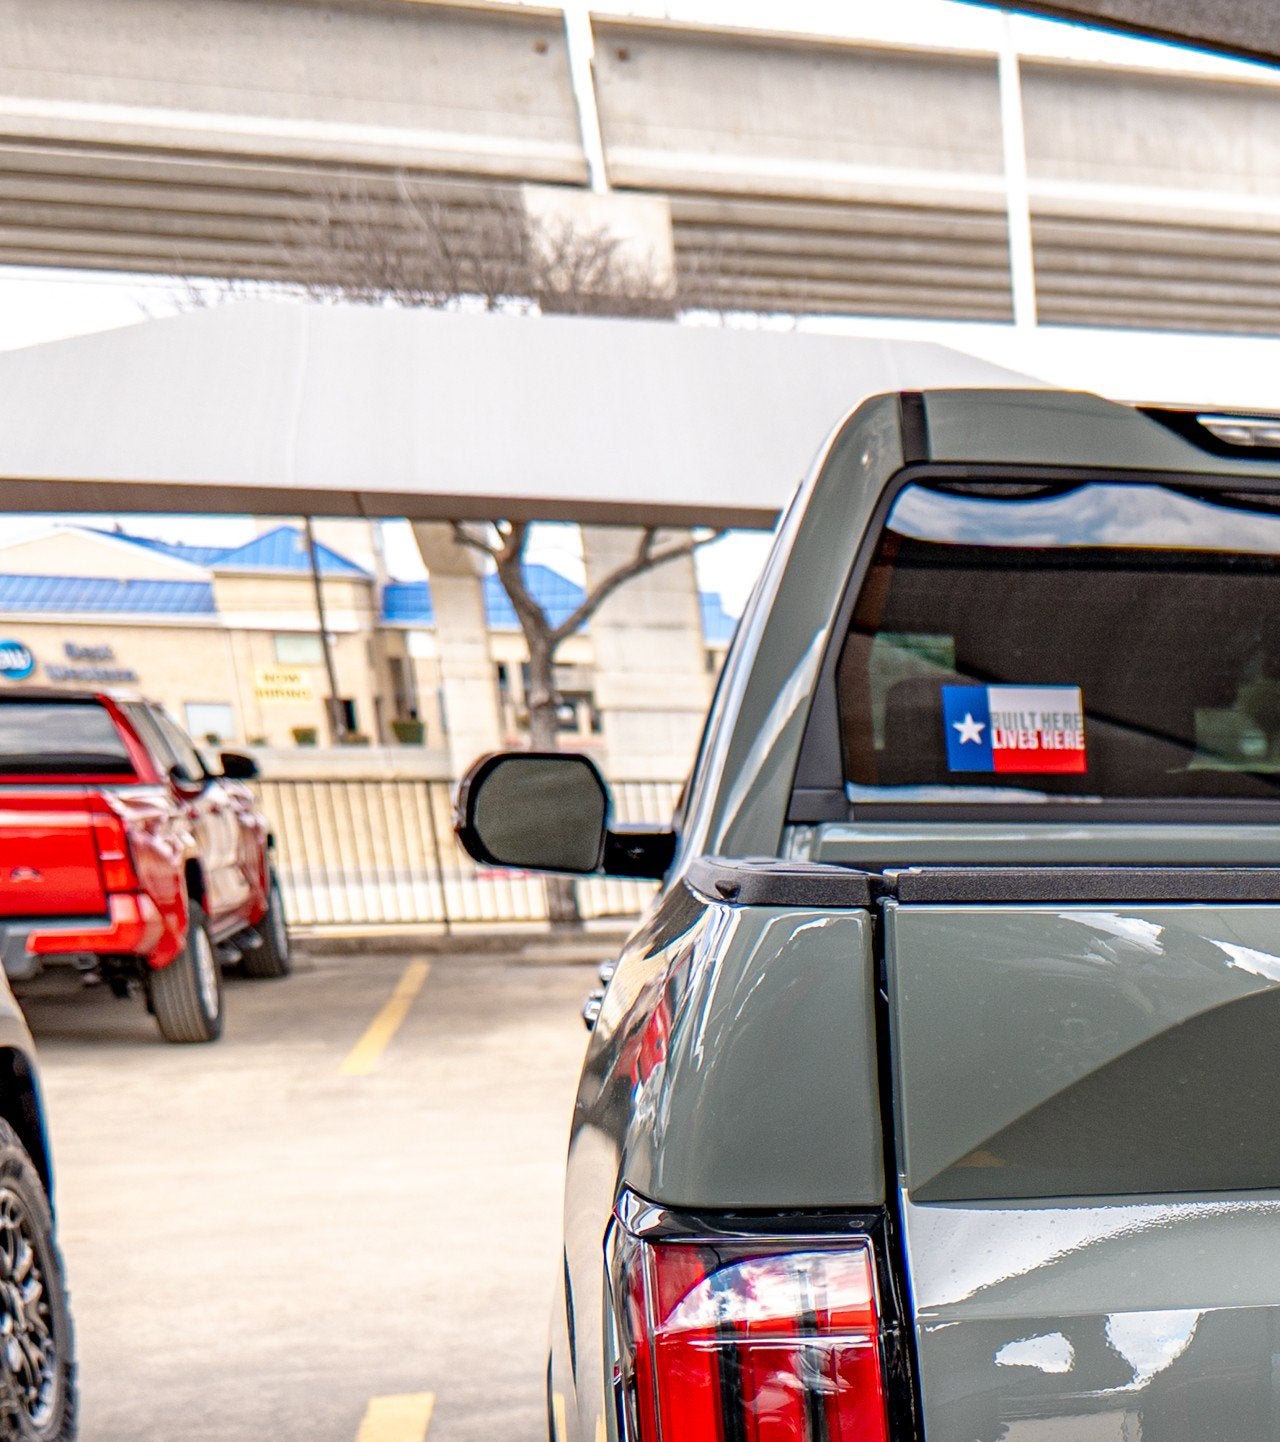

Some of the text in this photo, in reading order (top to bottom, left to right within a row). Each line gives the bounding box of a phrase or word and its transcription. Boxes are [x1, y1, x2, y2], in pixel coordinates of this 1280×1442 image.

[991, 712, 1084, 731] BUILT HERE
[993, 730, 1085, 749] LIVES HERE
